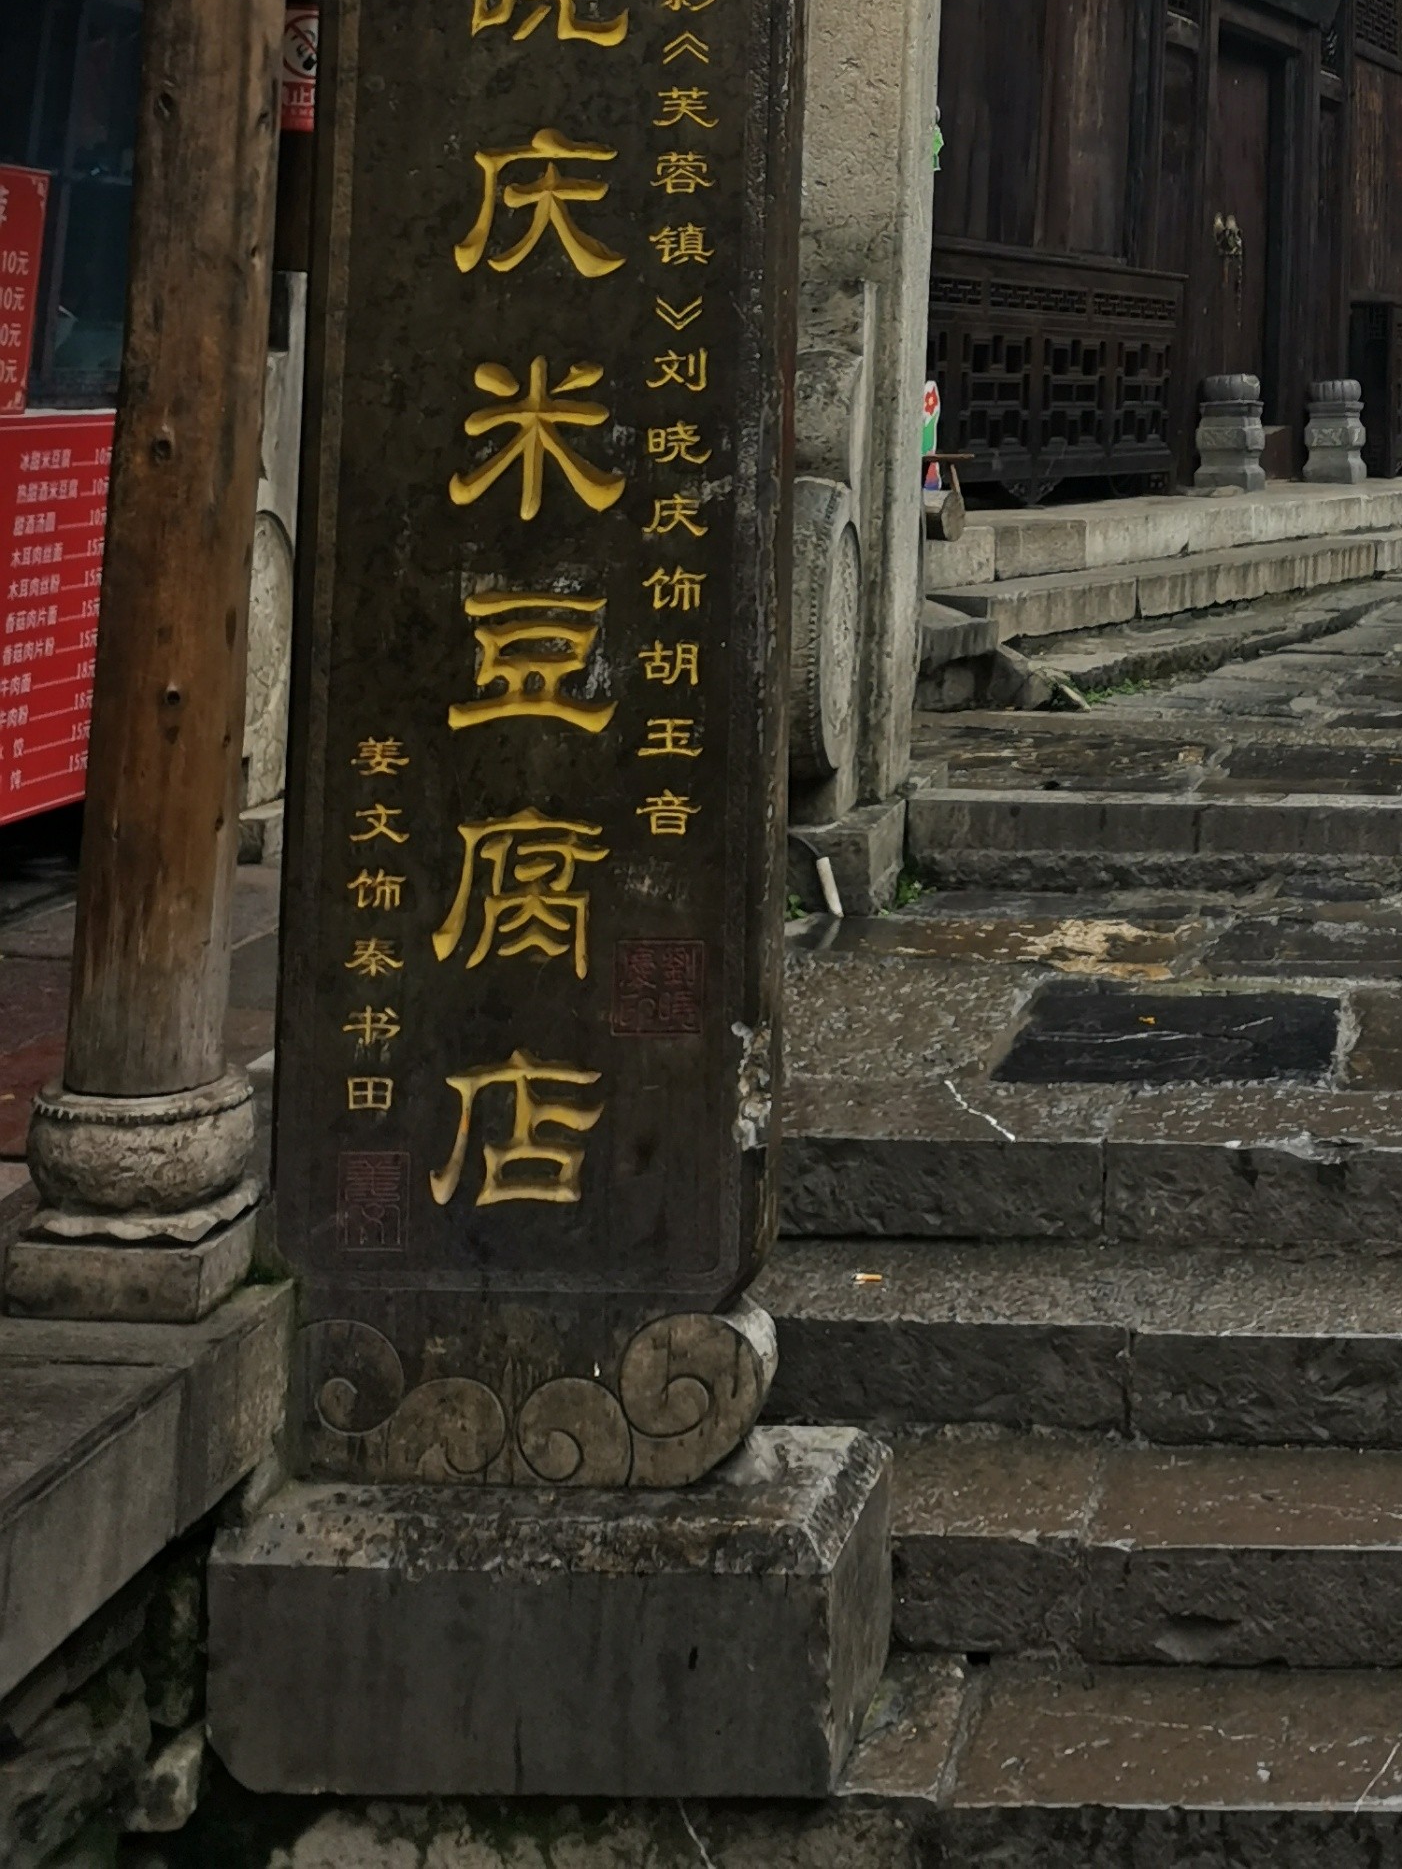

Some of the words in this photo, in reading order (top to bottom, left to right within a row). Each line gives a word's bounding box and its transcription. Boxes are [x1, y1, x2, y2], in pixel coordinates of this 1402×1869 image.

[342, 737, 410, 1111] 姜文饰秦书田
